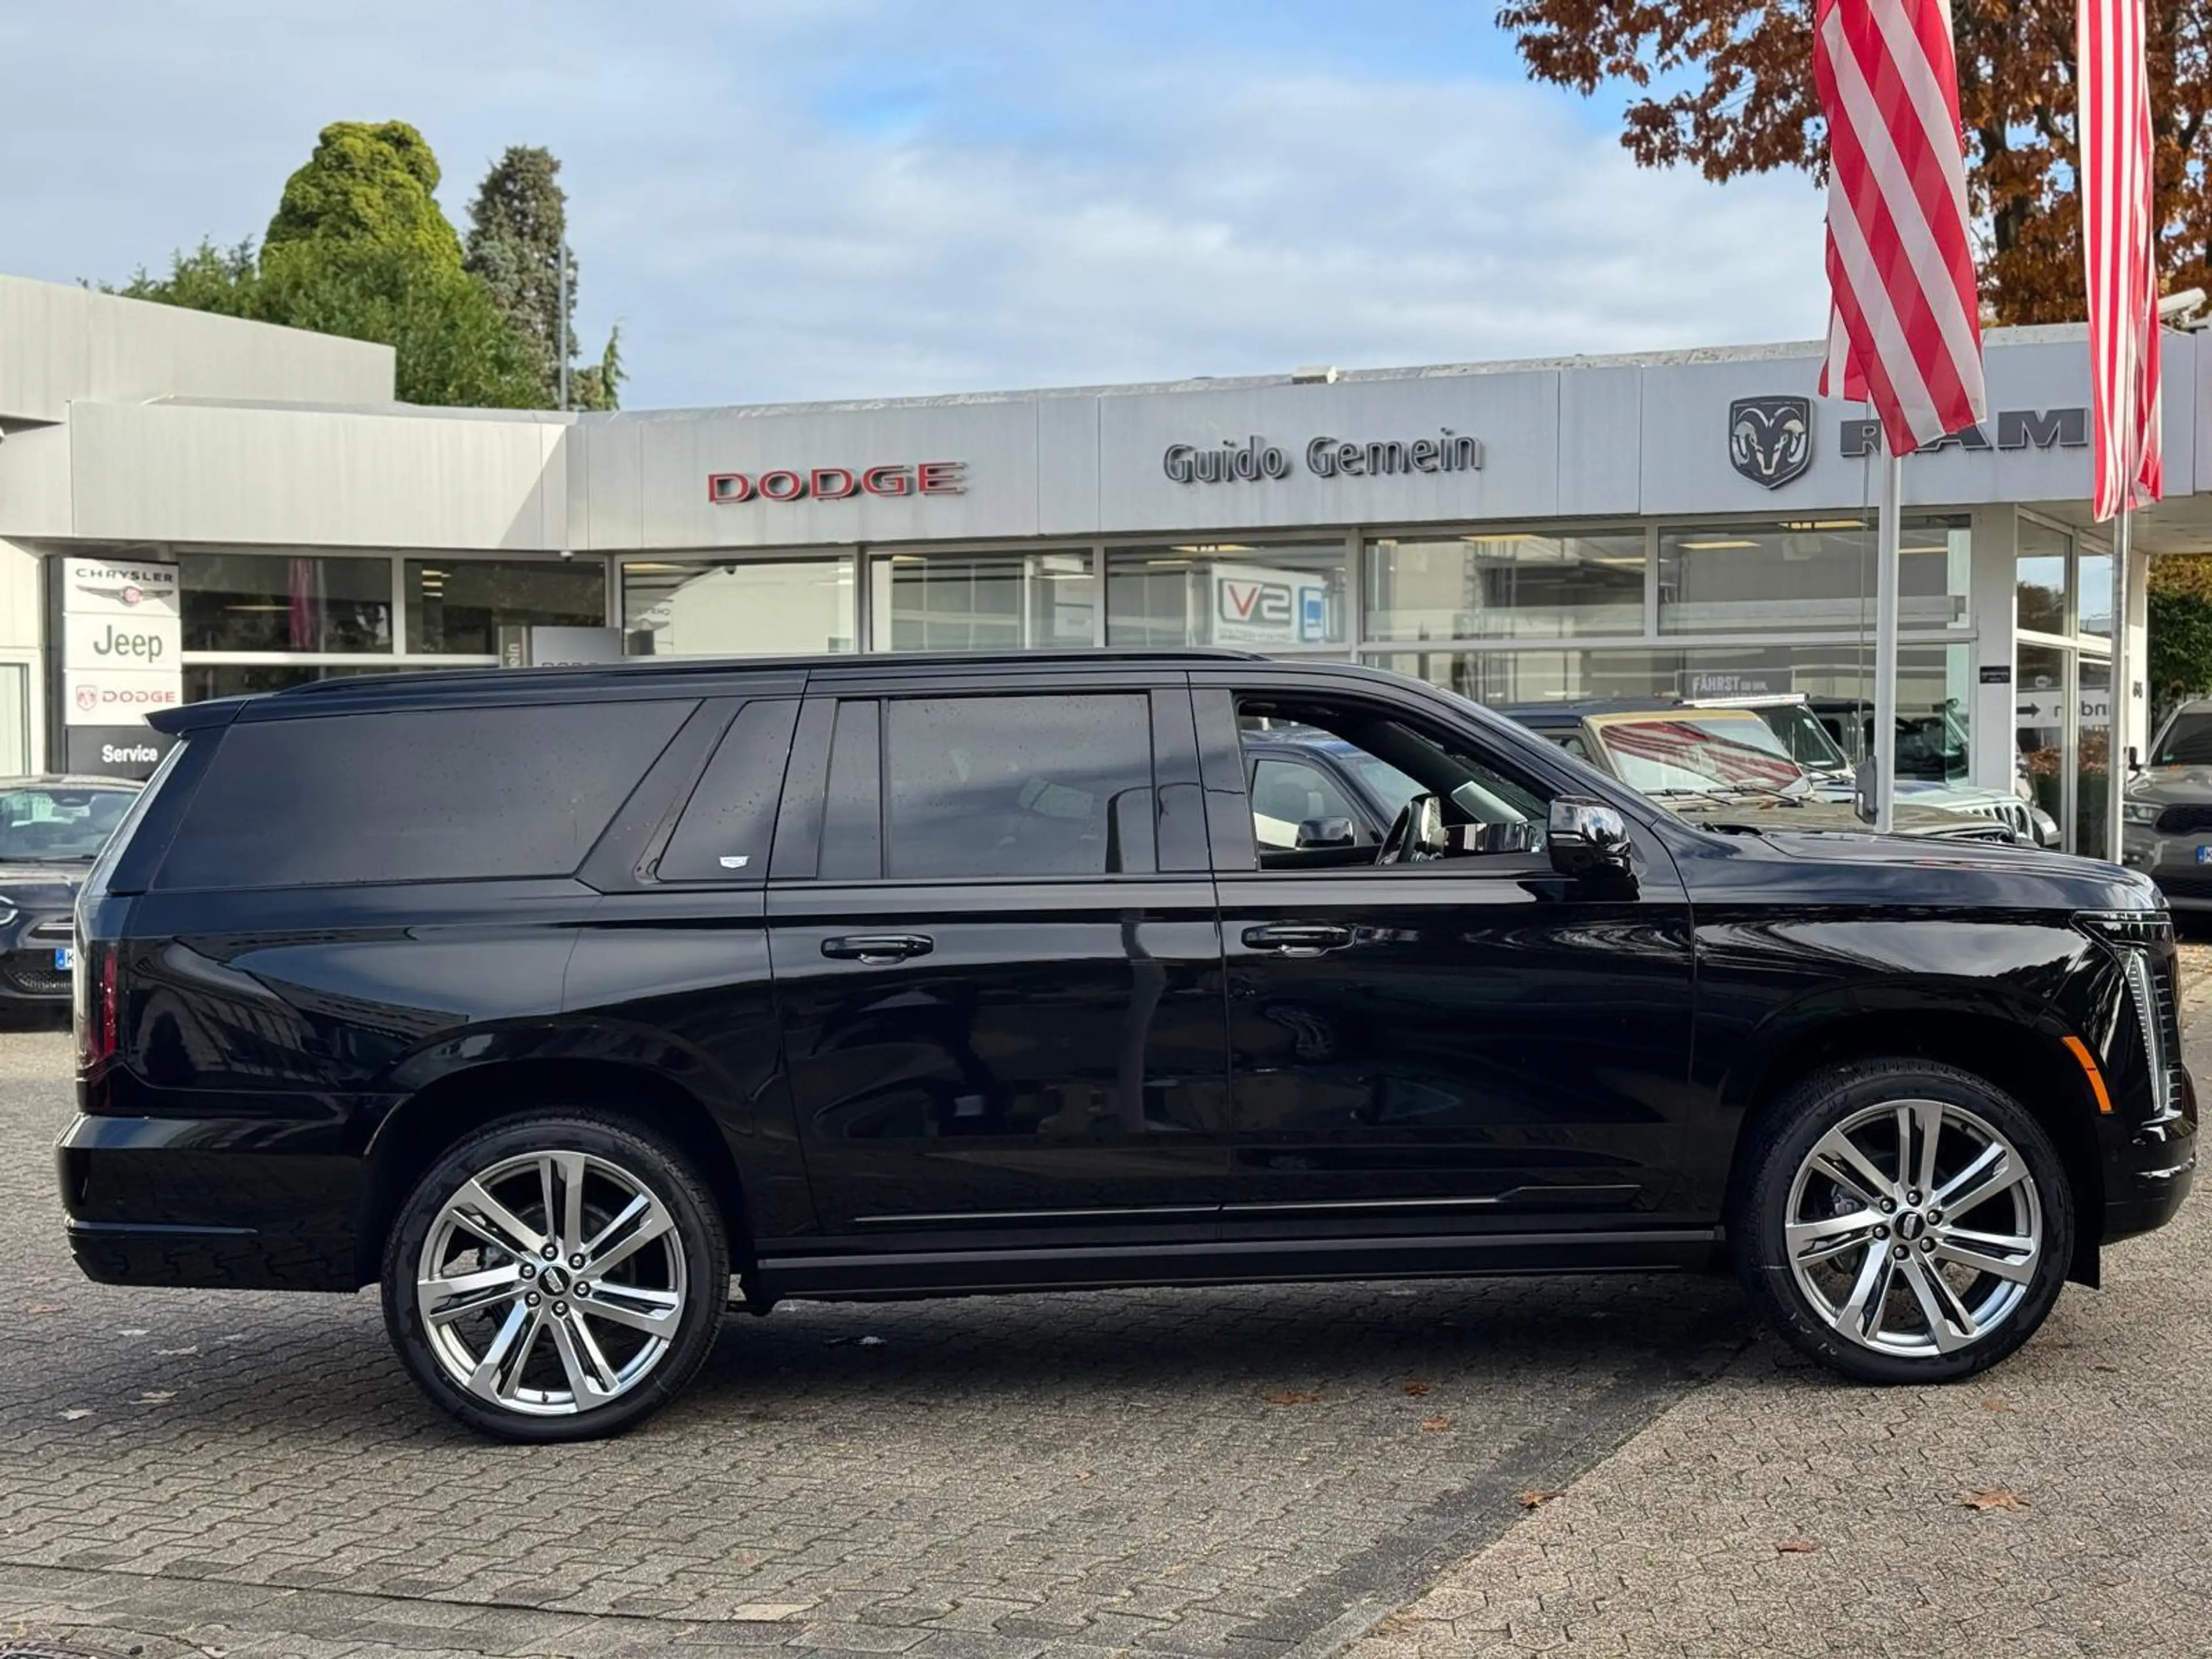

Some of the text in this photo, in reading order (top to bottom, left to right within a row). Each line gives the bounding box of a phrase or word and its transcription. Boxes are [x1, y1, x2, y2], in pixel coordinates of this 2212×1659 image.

[1164, 428, 1483, 482] Guido Gemein
[707, 461, 969, 503] DODGE
[75, 567, 173, 583] CHRYSLER
[93, 624, 162, 663] Jeep
[102, 691, 176, 703] DODGE
[101, 744, 158, 763] Service
